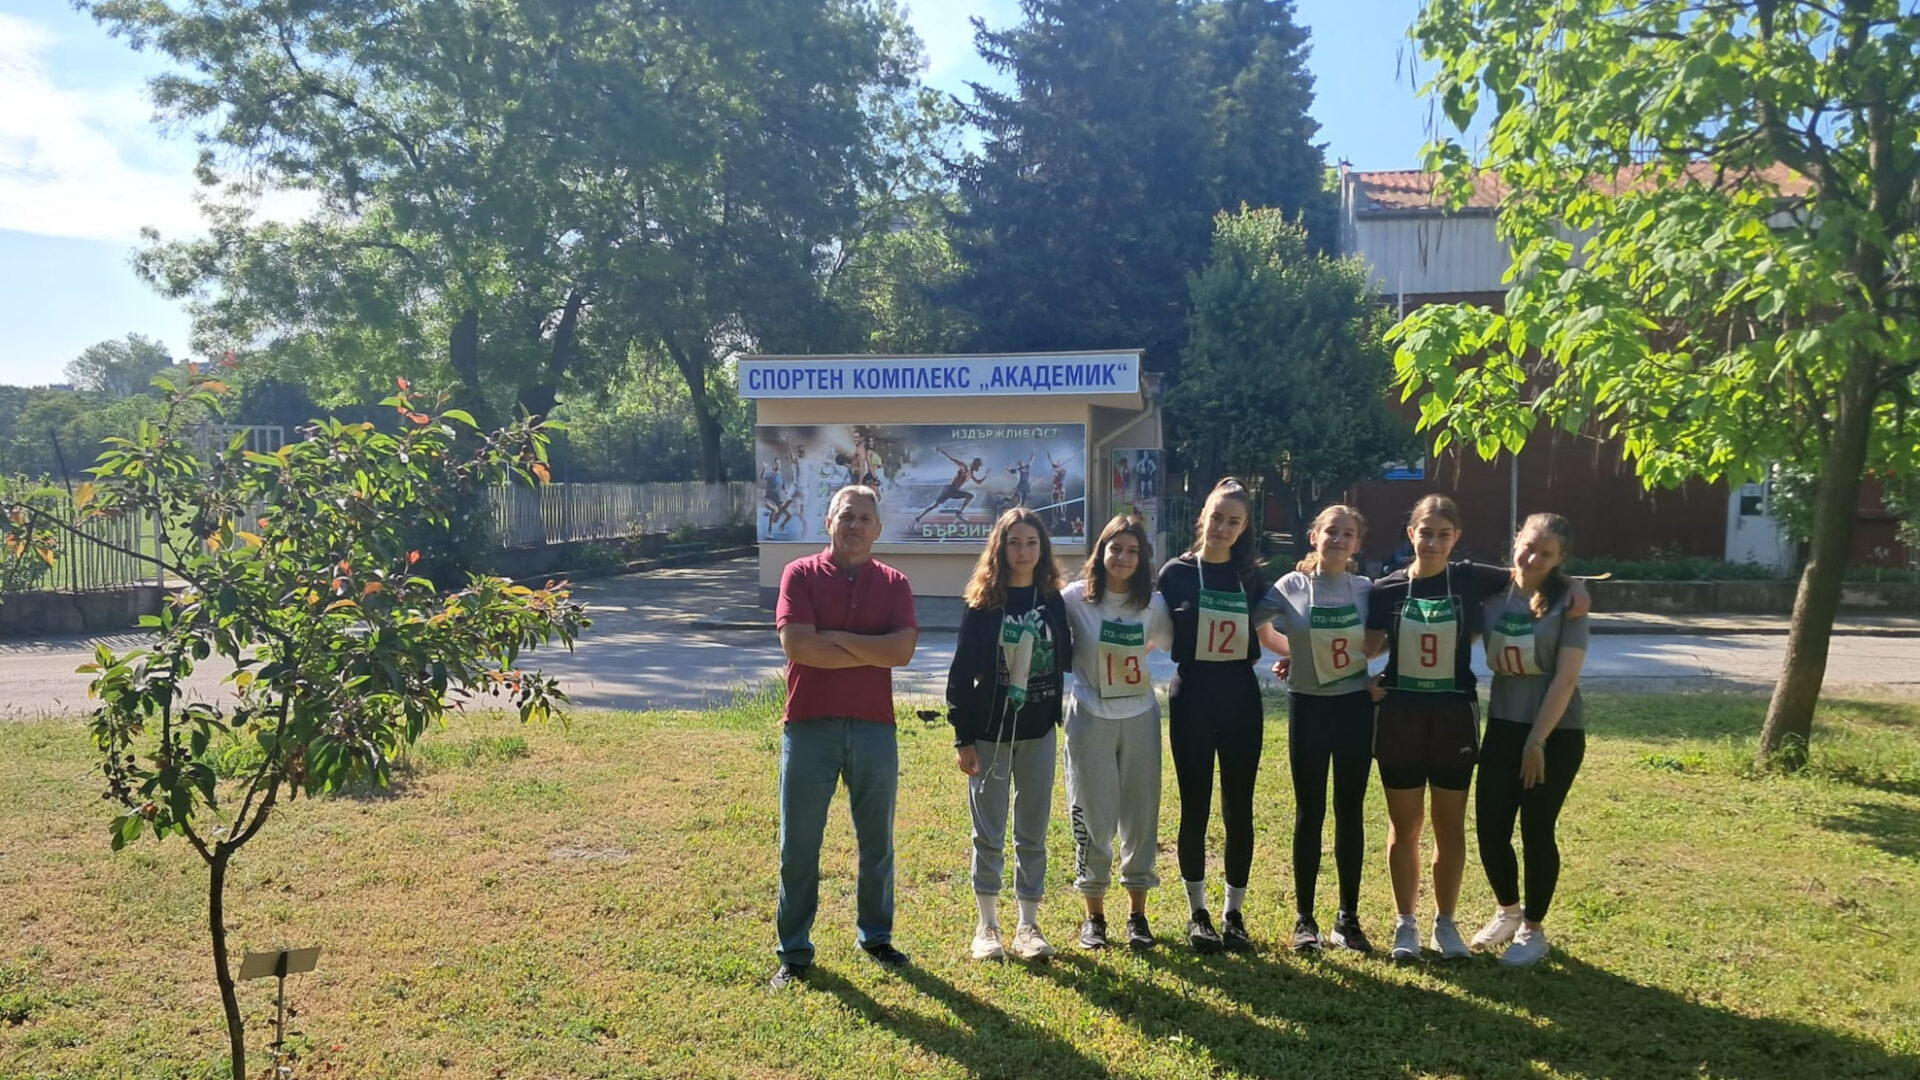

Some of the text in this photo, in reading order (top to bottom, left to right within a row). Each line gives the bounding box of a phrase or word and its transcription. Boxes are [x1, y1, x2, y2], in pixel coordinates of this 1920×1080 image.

[749, 368, 844, 391] СПОРТЕН
[853, 366, 971, 390] КОМПЛЕКС
[951, 427, 1058, 440] ИЗДЪРЖЛИВОСТ
[922, 523, 993, 538] БЪРЗИН
[1207, 619, 1237, 654] 12
[1420, 633, 1438, 668] 9
[1106, 652, 1142, 687] 13
[1331, 637, 1351, 670] 8
